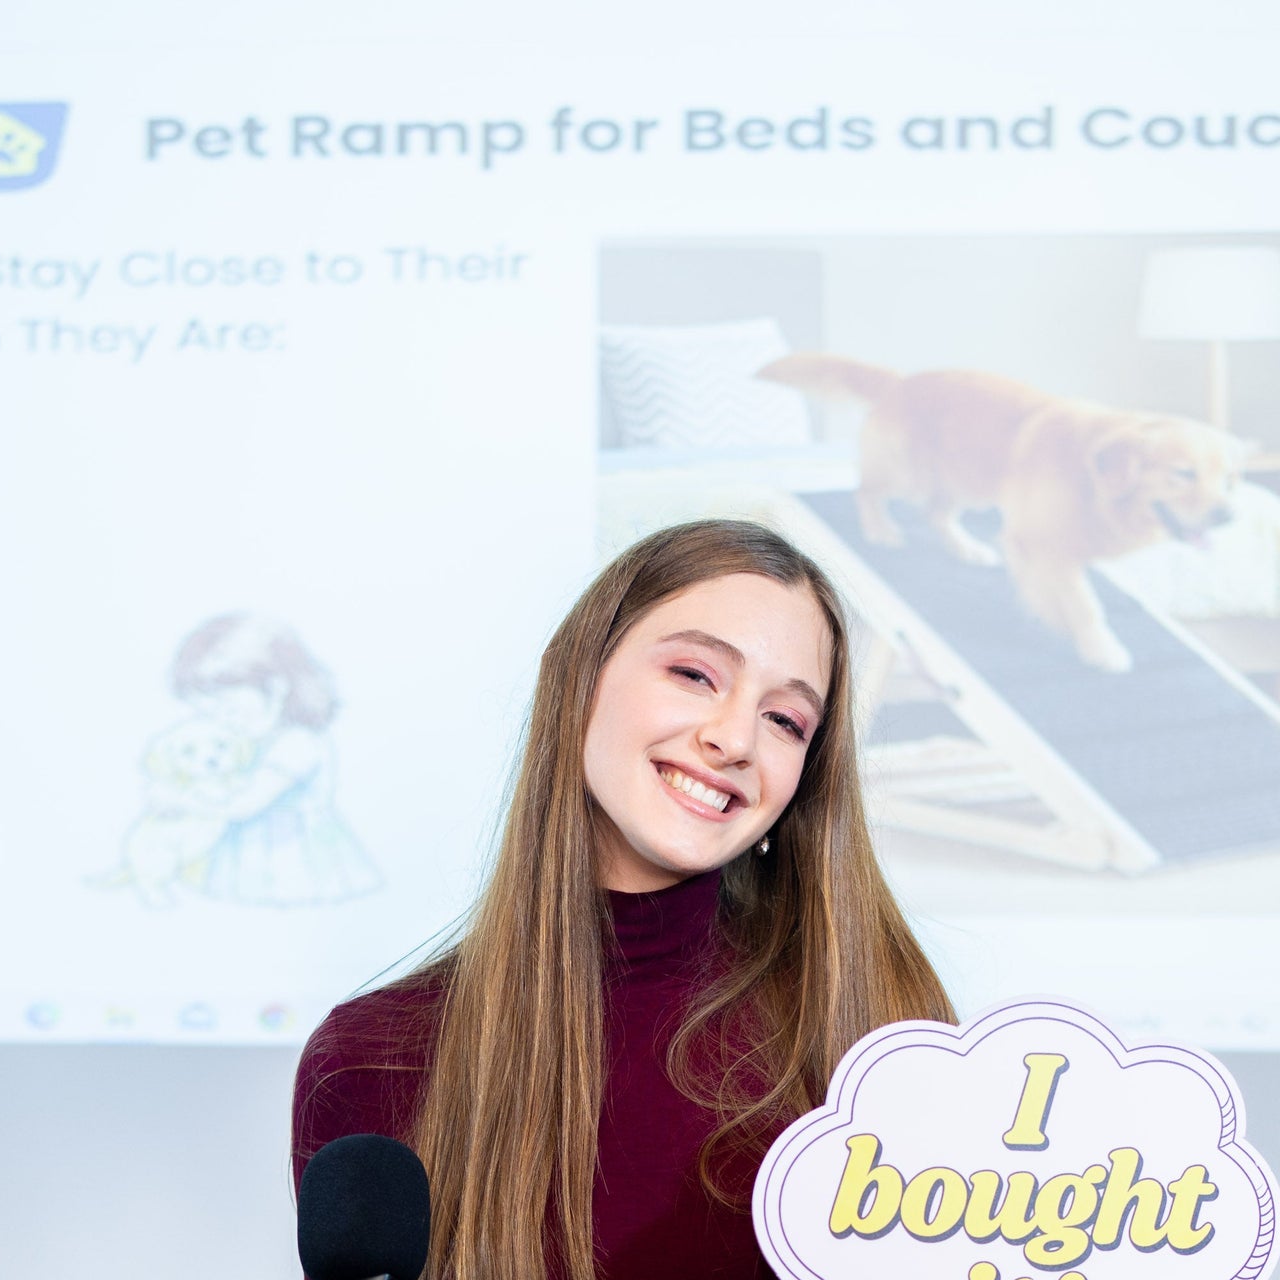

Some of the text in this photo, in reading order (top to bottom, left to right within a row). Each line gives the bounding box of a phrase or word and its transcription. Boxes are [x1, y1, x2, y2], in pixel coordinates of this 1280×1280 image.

[144, 114, 266, 162] Pet
[291, 111, 525, 170] Ramp
[551, 105, 659, 154] for
[684, 104, 876, 155] Beds
[900, 102, 1054, 152] and
[118, 248, 286, 287] Close
[306, 248, 364, 285] to
[386, 244, 529, 284] Their
[19, 317, 156, 362] They
[177, 316, 287, 352] Are:
[1002, 1052, 1070, 1151] I
[828, 1133, 1219, 1272] bought
